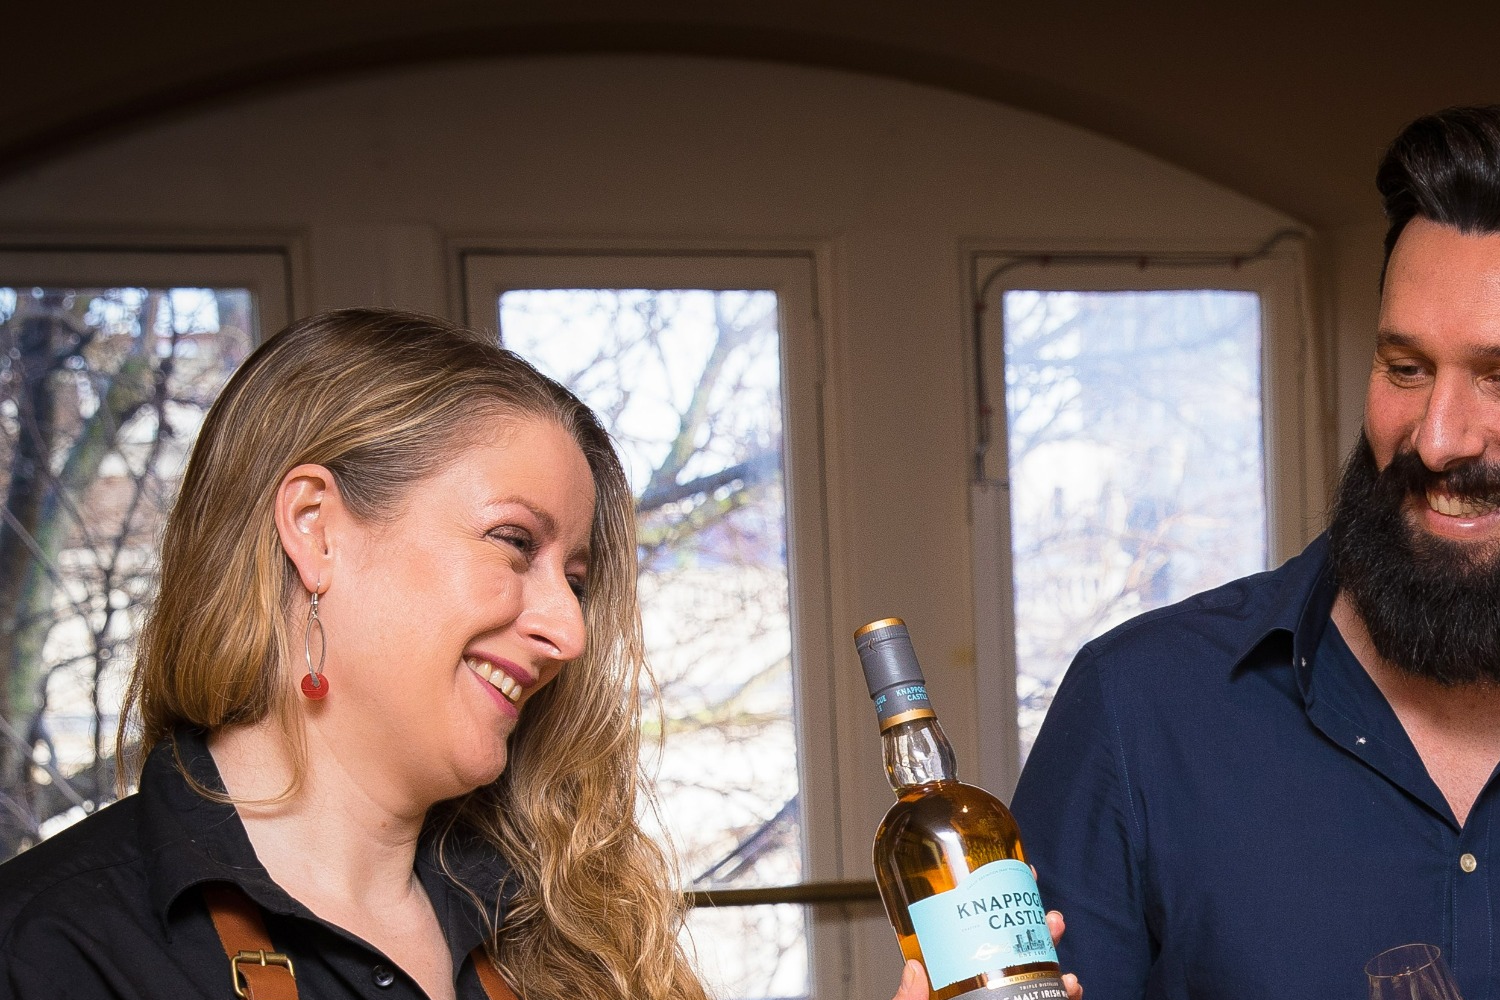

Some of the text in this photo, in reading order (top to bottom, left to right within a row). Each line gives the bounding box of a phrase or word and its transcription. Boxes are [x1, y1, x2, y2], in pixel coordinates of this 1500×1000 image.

[956, 892, 1044, 919] KNAPPOG
[988, 910, 1046, 930] CASTLE
[1040, 989, 1062, 999] IRISH
